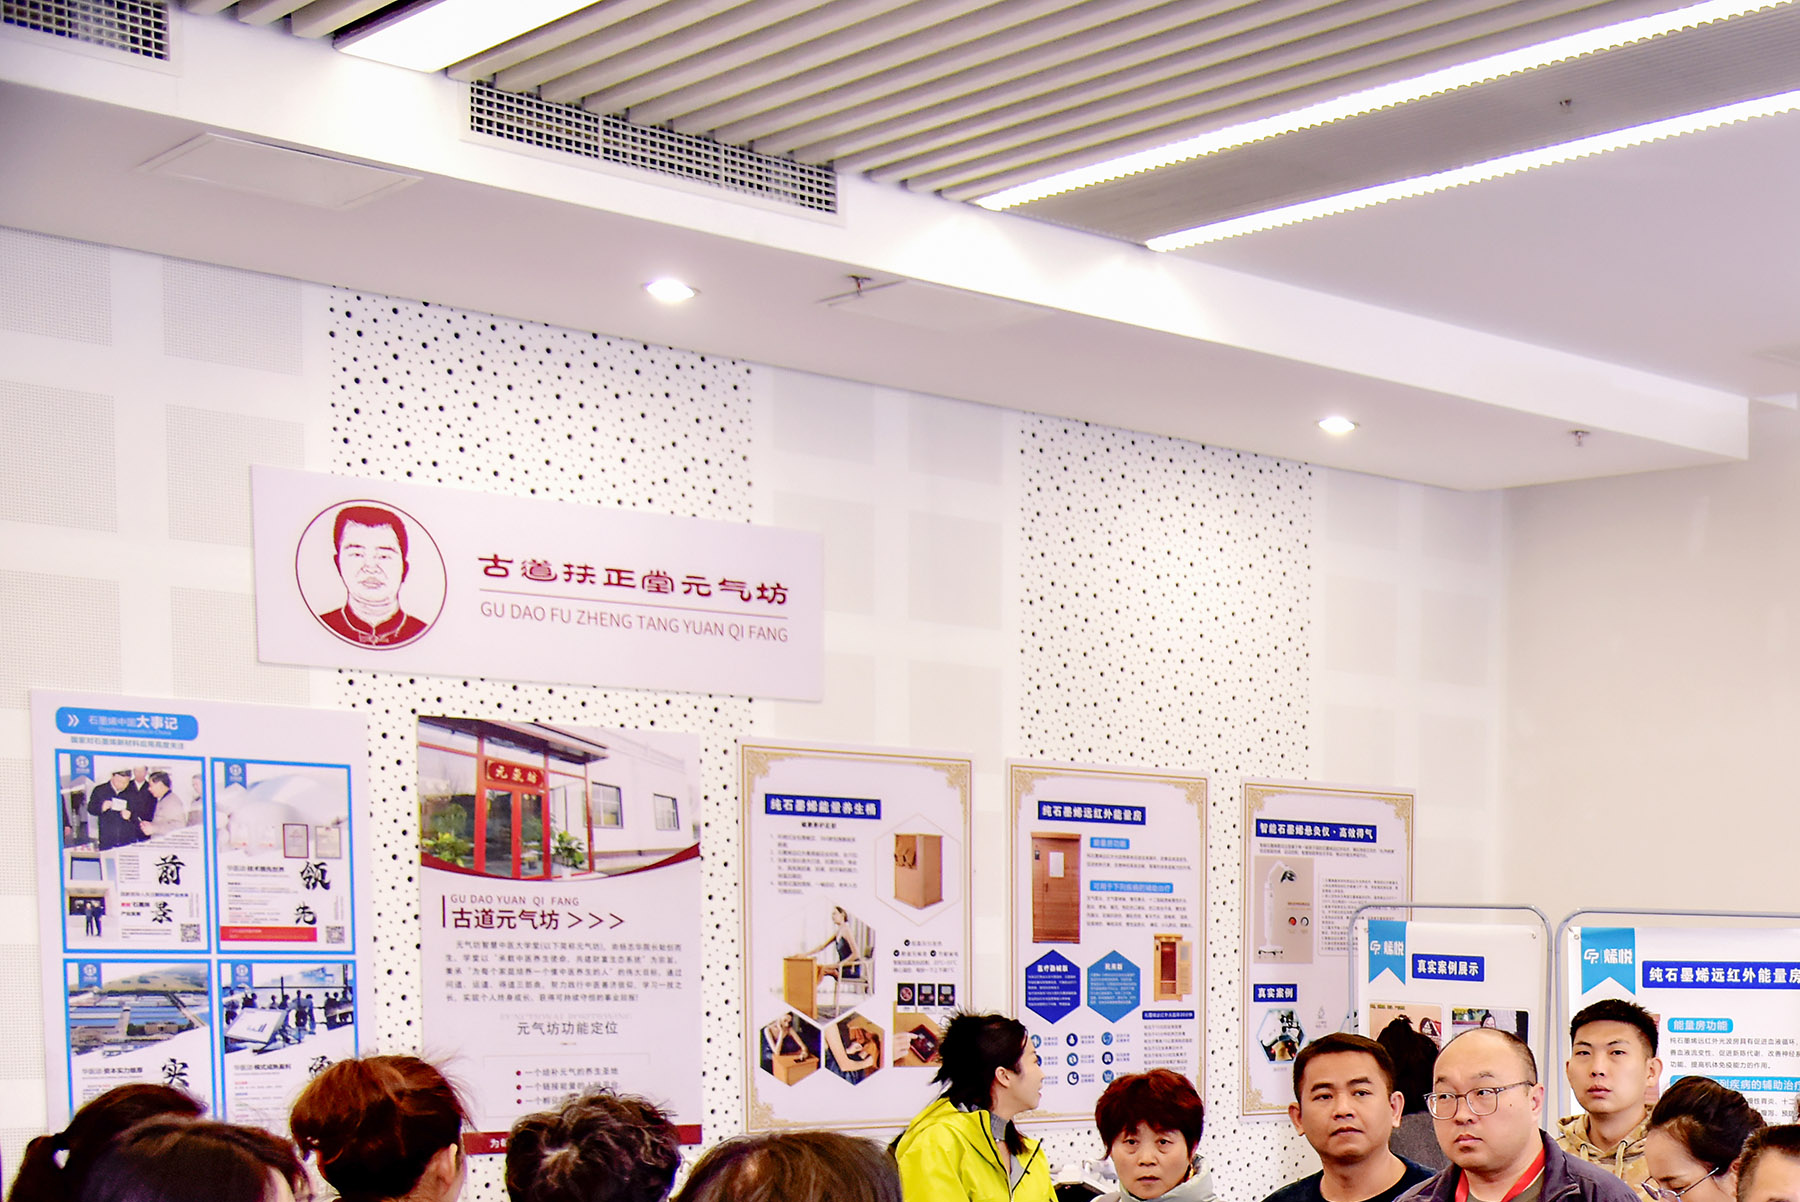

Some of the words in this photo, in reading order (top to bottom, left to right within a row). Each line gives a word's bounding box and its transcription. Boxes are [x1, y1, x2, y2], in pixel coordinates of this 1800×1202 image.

[478, 554, 789, 605] 古道扶正堂元气坊
[480, 601, 505, 618] GU
[510, 603, 546, 622] DAO
[550, 607, 571, 624] FU
[576, 610, 633, 630] ZHENG
[636, 615, 680, 634] TANG
[682, 619, 724, 637] YUAN
[728, 623, 745, 642] QI
[748, 625, 789, 643] FANG
[770, 798, 877, 816] 纯石墨烯能量养生桶
[1042, 805, 1143, 822] 纯石墨烯远红外能量房
[450, 894, 466, 904] GU
[470, 895, 494, 904] DAO
[496, 895, 526, 905] YUAN
[532, 896, 544, 907] QI
[551, 896, 579, 906] FANG
[451, 907, 560, 930] 古道元气坊
[1604, 948, 1633, 964] 烯悦
[1417, 959, 1479, 976] 真实案例展示
[1258, 987, 1294, 999] 真实案例
[517, 1021, 619, 1036] 元气坊功能定位
[1673, 1020, 1728, 1031] 能量房功能
